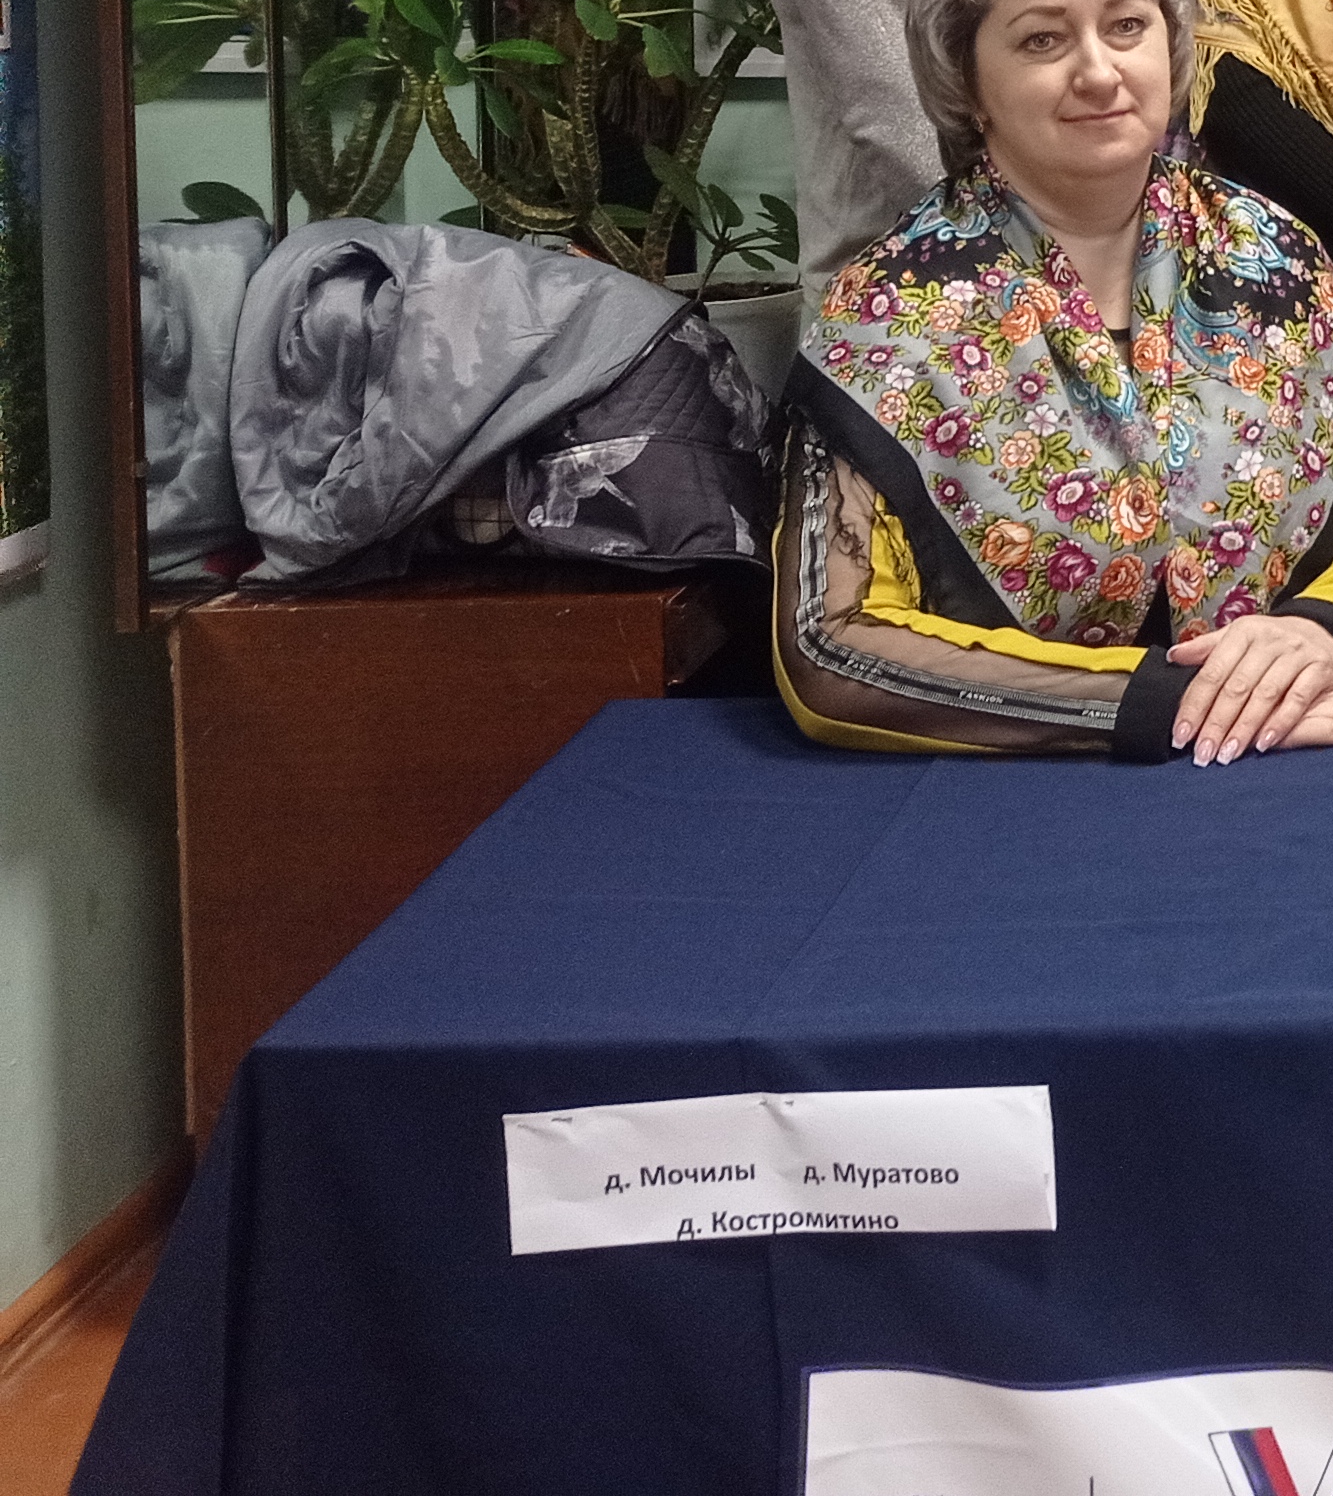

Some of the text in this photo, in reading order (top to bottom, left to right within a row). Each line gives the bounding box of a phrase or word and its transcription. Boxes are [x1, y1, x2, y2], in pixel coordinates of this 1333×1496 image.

[604, 1162, 960, 1195] д. Мочилы д. Муратово
[676, 1211, 900, 1241] д. Костромитино
